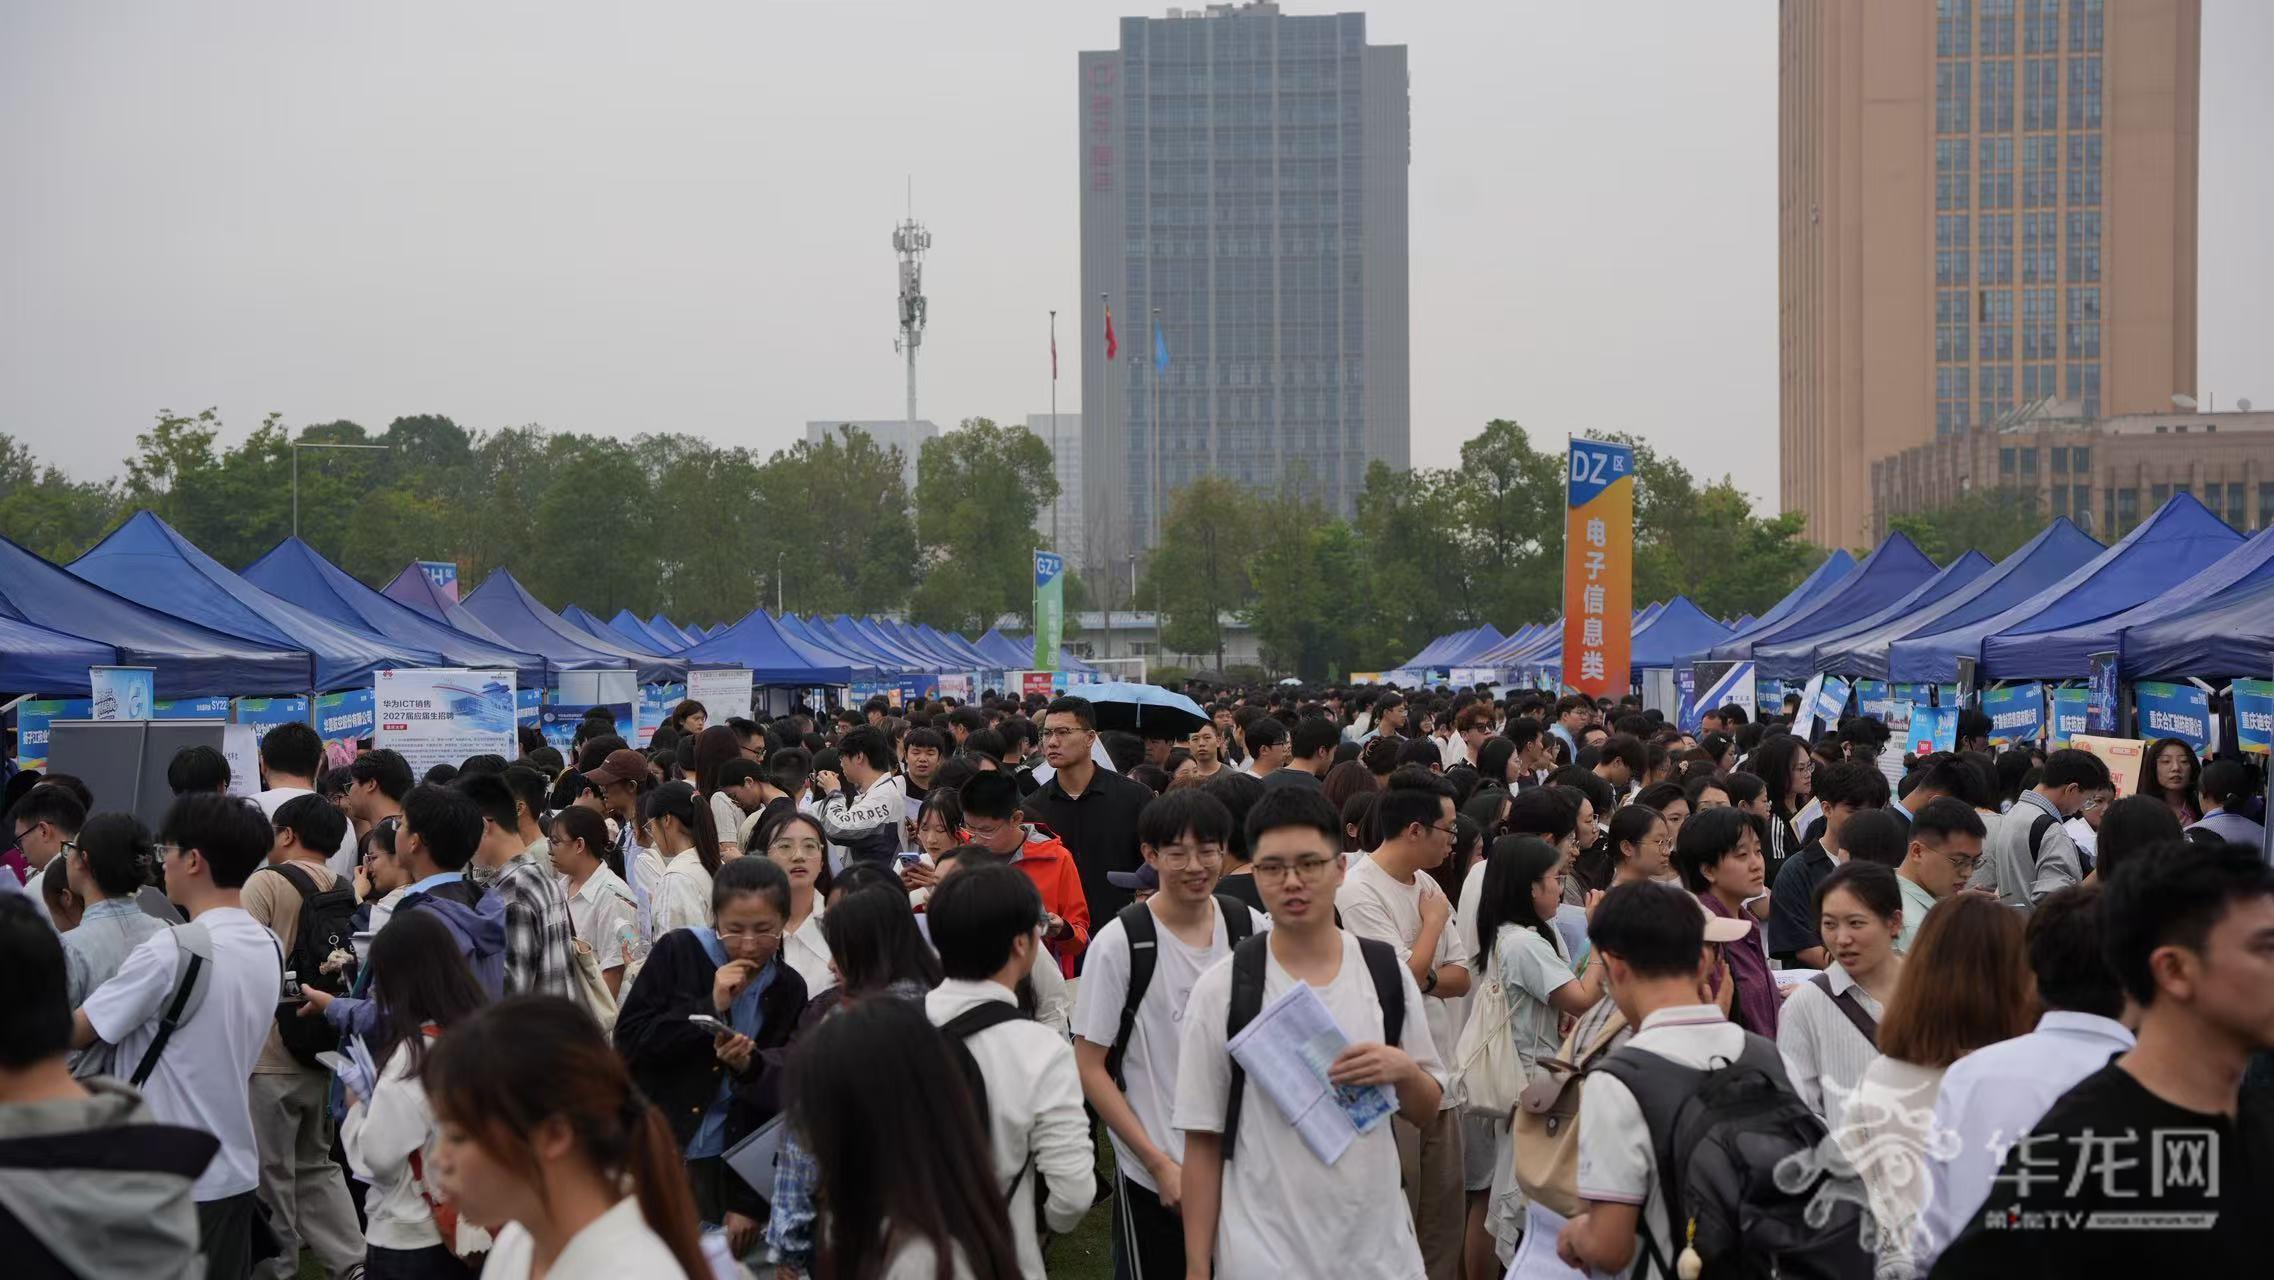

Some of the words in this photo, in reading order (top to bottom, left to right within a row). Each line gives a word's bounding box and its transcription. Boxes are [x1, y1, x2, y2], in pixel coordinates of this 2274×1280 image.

[1581, 518, 1607, 681] 电子信息类
[383, 699, 431, 708] 华为ICT销售
[383, 711, 454, 721] 2027届应届生招聘
